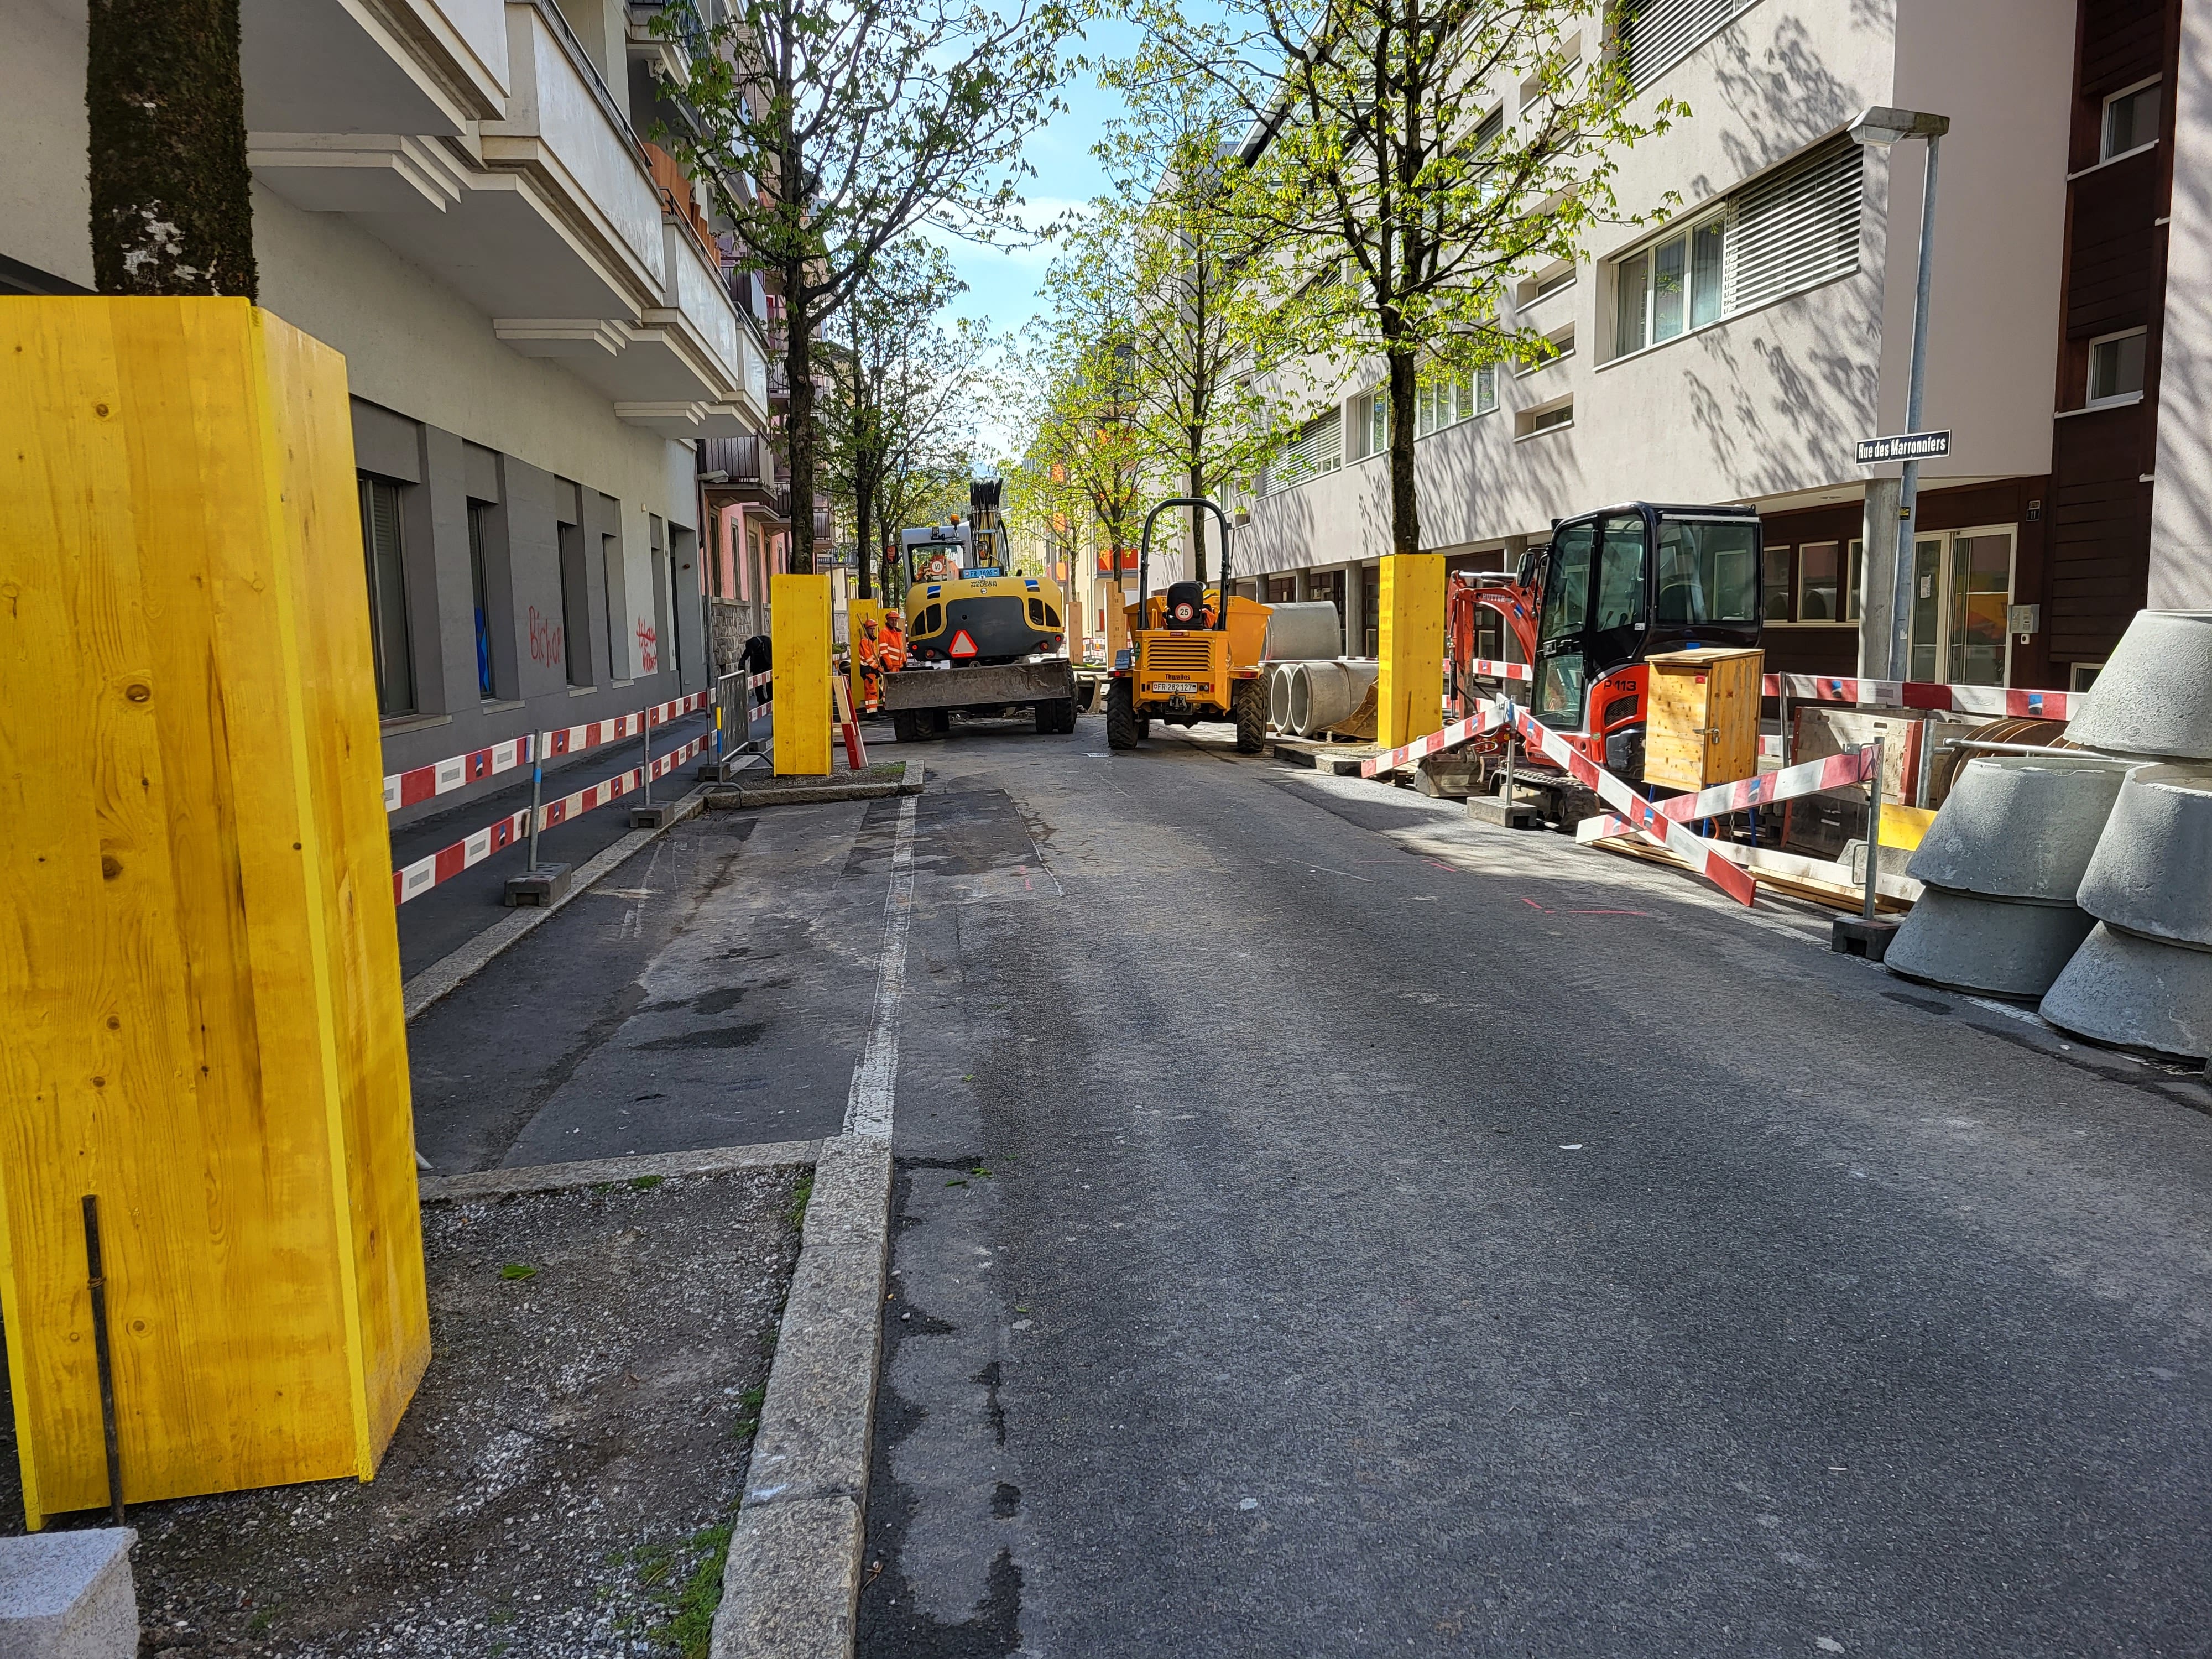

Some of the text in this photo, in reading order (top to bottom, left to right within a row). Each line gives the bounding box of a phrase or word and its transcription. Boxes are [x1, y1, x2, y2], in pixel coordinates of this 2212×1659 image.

[1858, 436, 1946, 460] Rue des Marronniers
[1483, 593, 1505, 602] HUTTER
[1604, 680, 1637, 691] P 113
